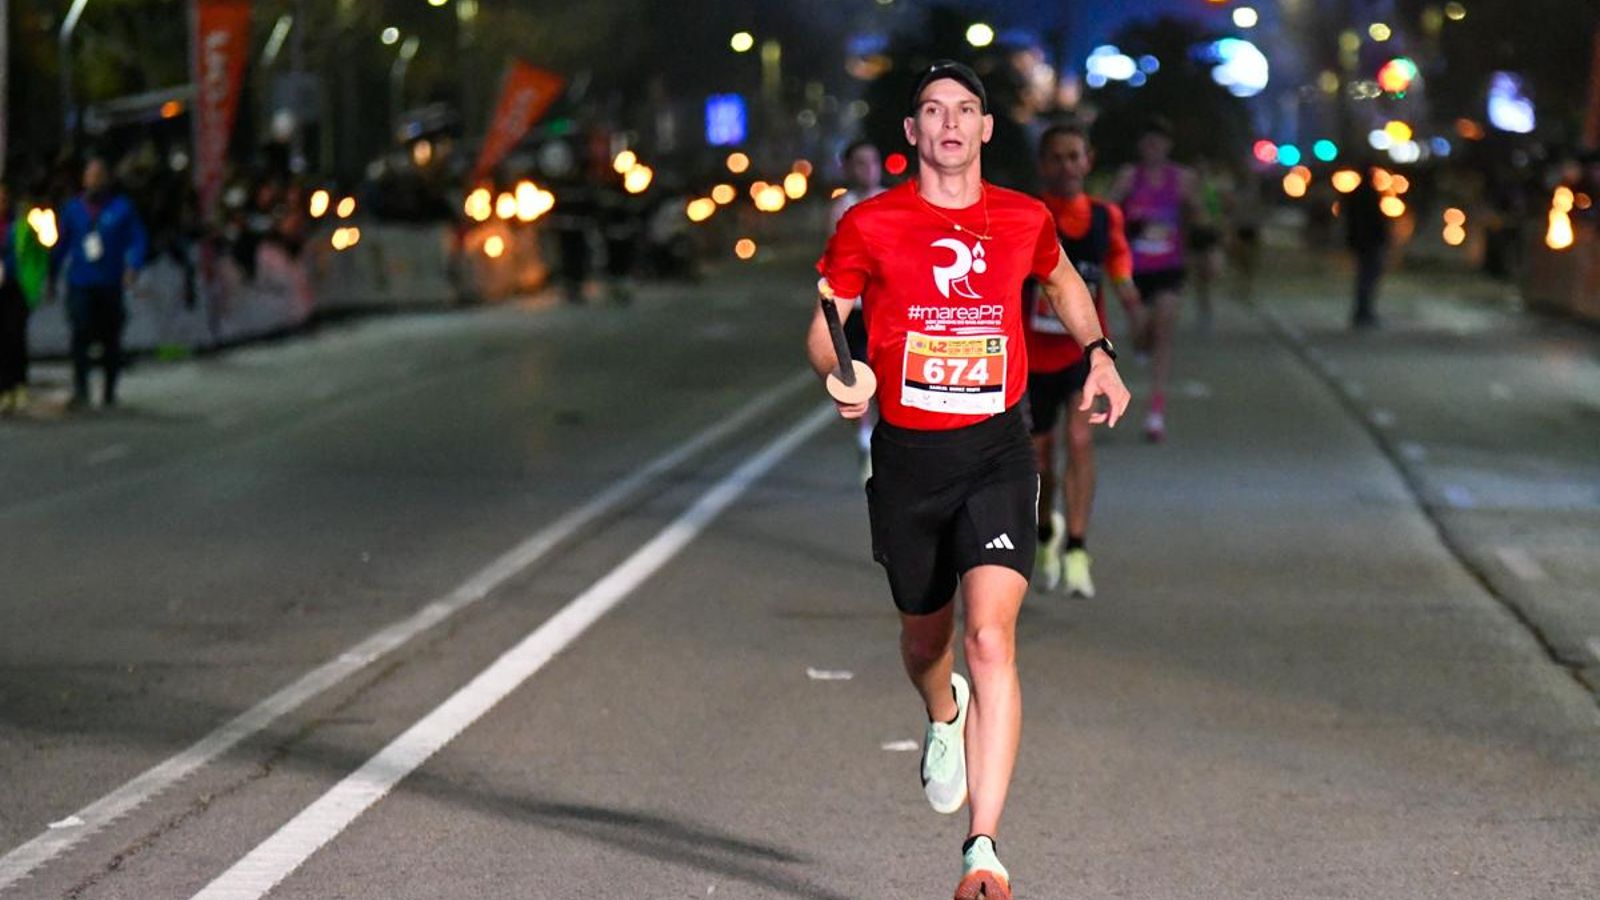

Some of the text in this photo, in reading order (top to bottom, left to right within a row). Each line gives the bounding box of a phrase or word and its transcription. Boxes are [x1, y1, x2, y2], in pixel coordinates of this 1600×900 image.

[908, 305, 1003, 319] #mareaPR
[928, 341, 947, 353] 42
[923, 358, 989, 385] 674
